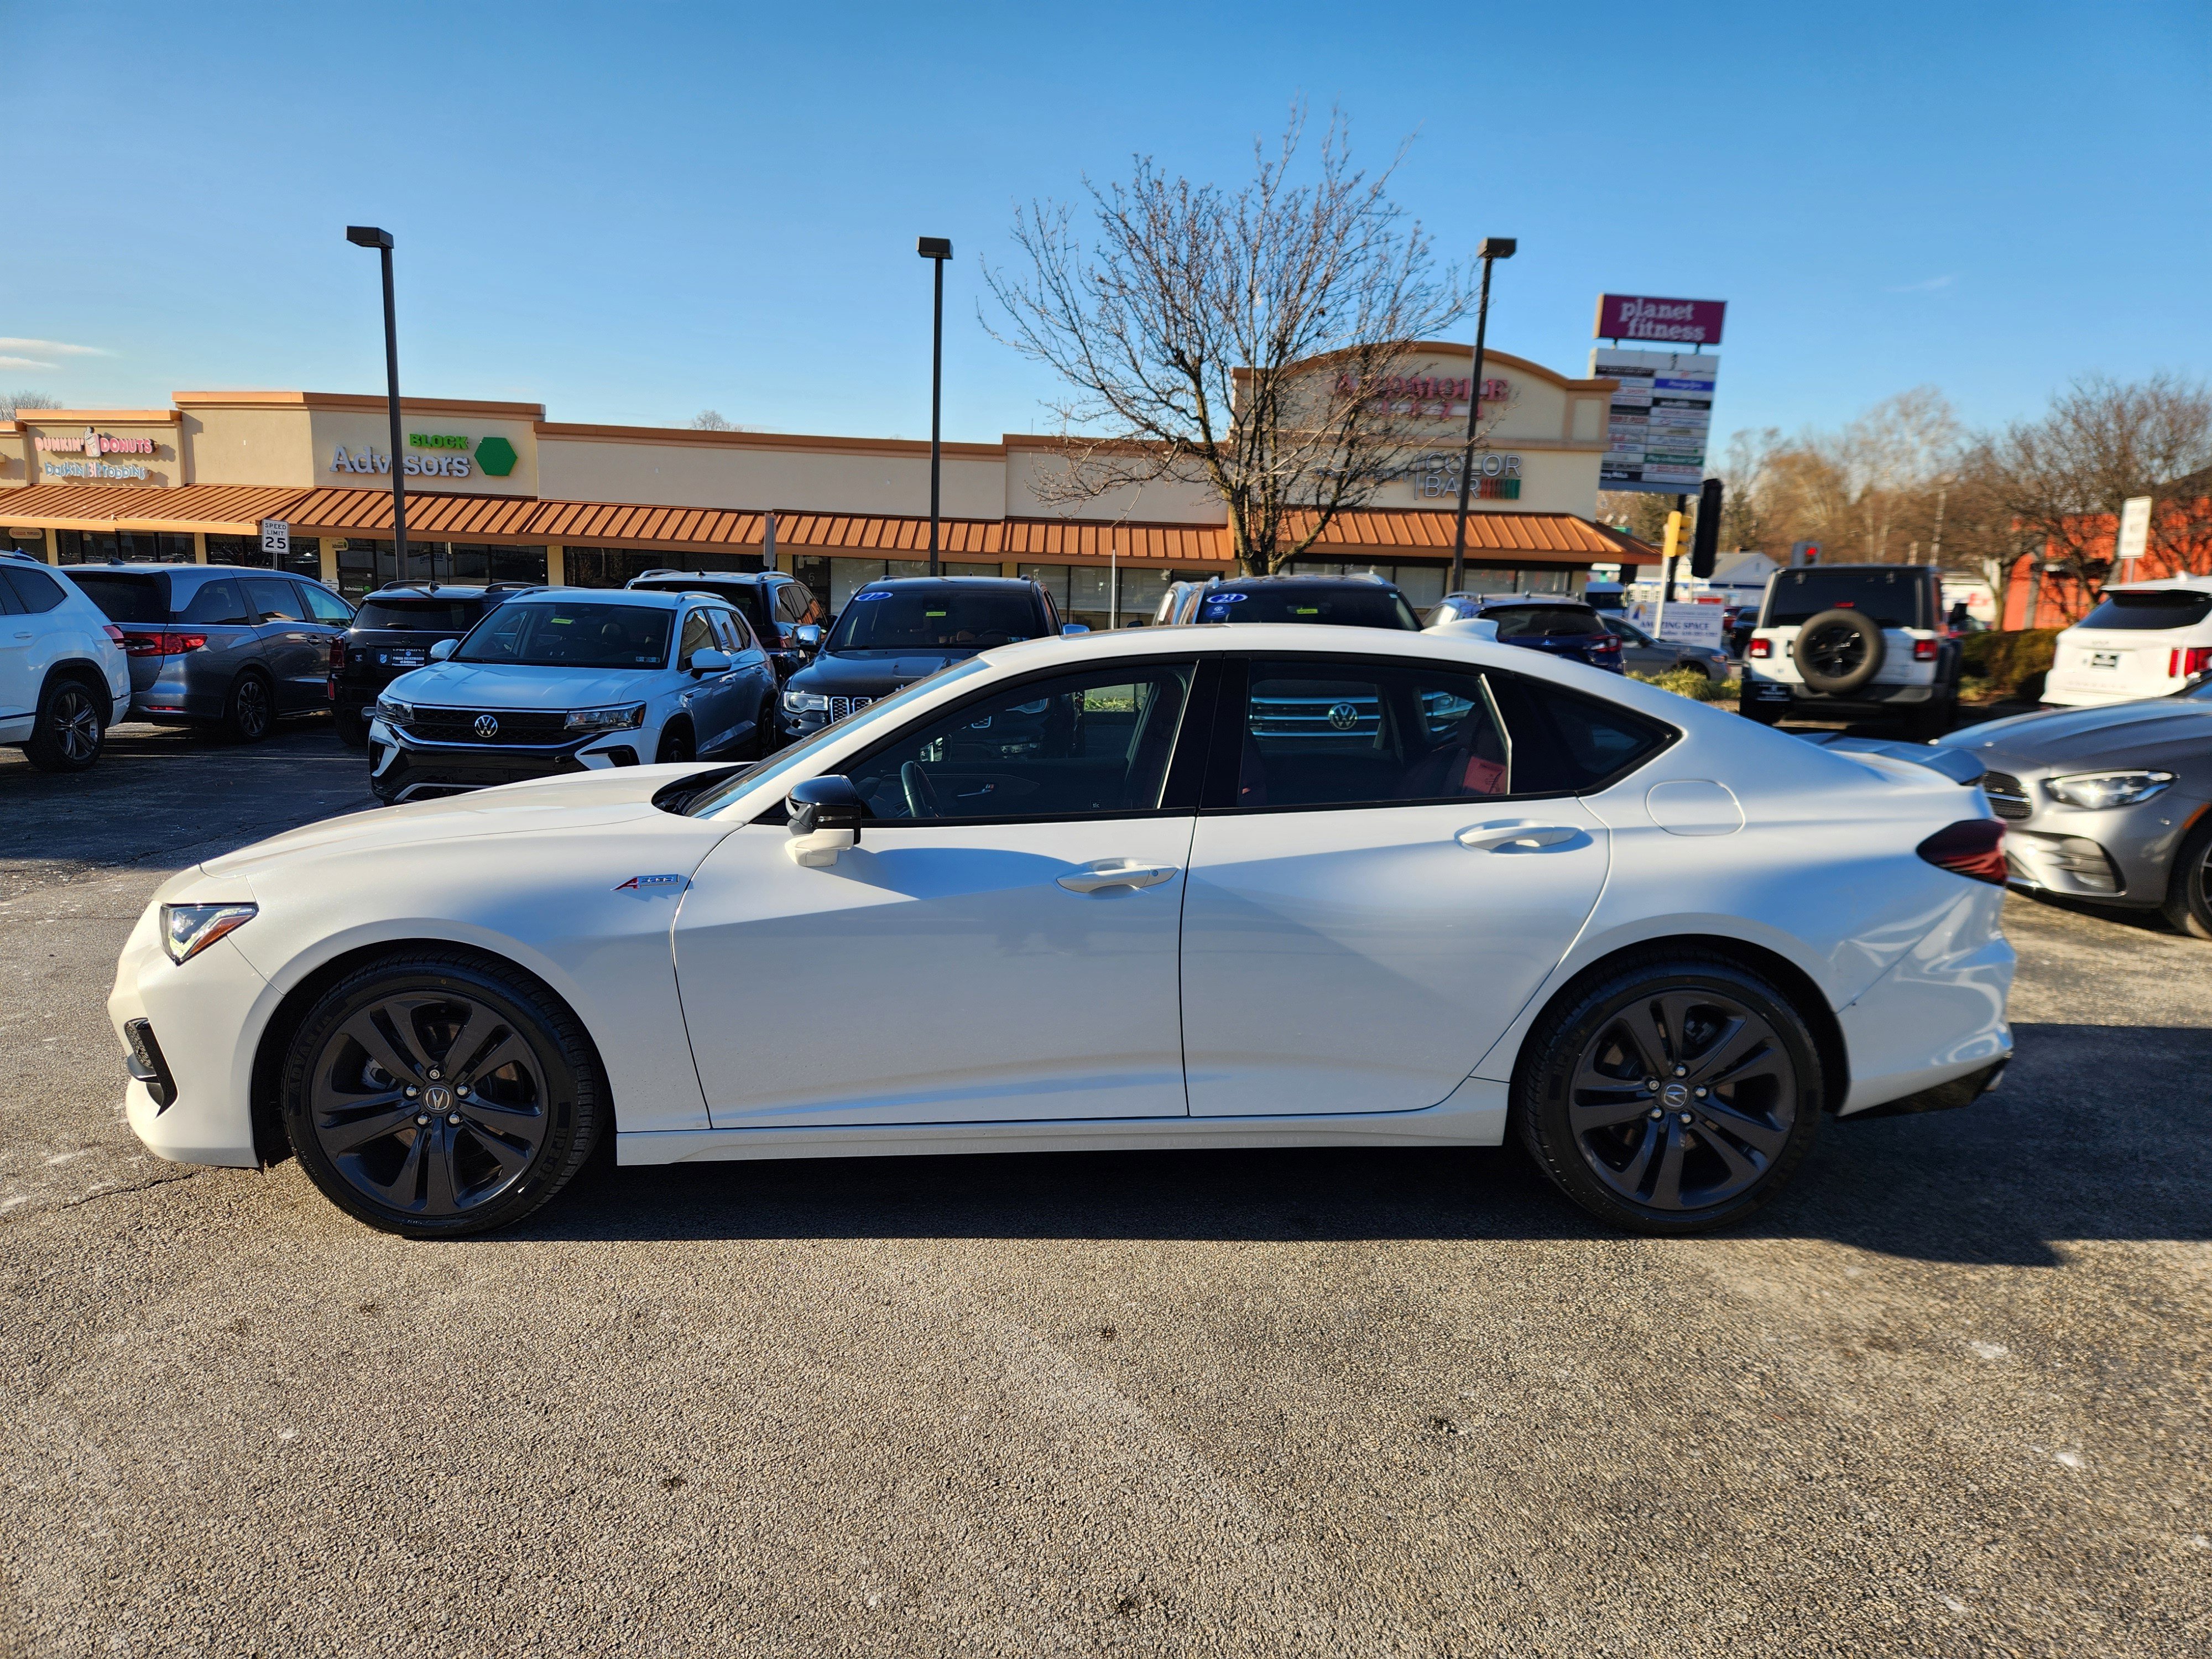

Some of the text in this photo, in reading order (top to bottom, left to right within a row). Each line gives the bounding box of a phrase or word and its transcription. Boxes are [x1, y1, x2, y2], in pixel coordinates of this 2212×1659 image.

[1619, 299, 1693, 322] planet
[1627, 317, 1706, 341] fitness
[100, 437, 153, 453] DONUTS
[409, 434, 469, 450] BLOCK
[330, 445, 470, 477] Advsors
[265, 536, 286, 549] 25
[1217, 594, 1237, 602] 23
[1683, 623, 1709, 631] SPACE
